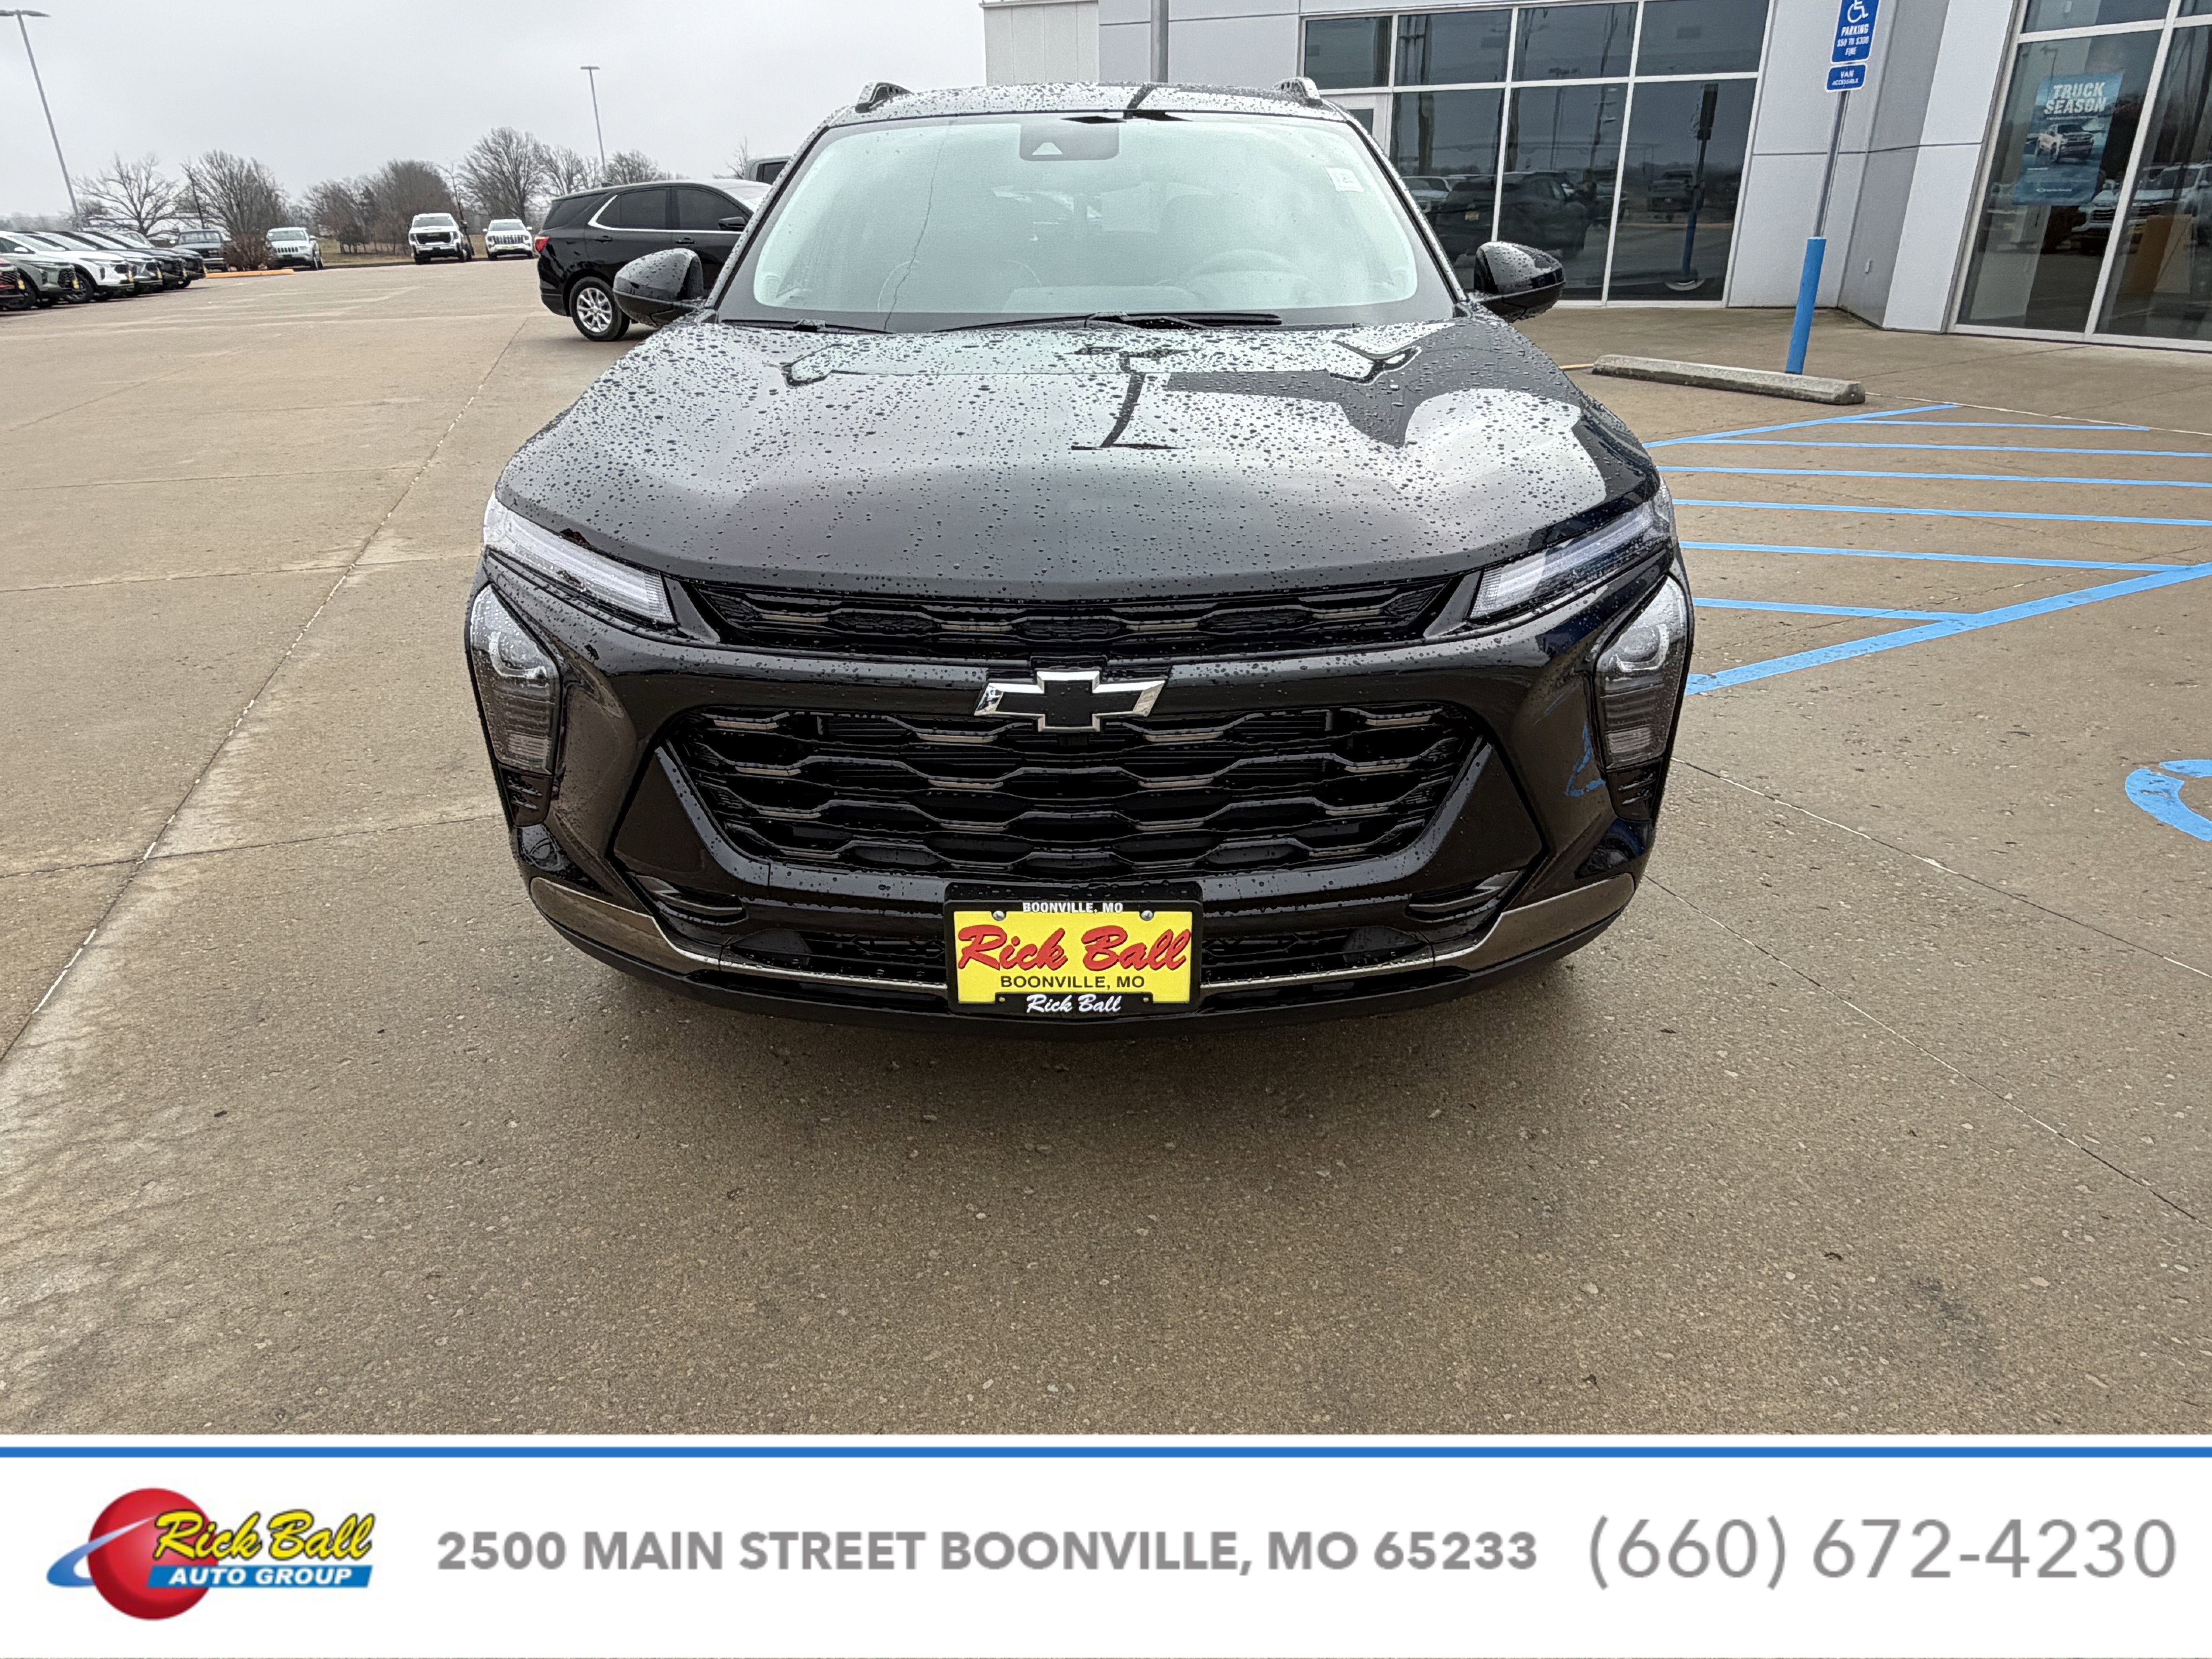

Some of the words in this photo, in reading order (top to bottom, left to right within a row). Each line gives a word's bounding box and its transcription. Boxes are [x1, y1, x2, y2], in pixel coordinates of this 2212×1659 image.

[1841, 24, 1869, 36] PARKING
[1845, 47, 1857, 56] FINE
[1840, 70, 1854, 79] VAN
[2053, 81, 2107, 100] TRUCK
[2043, 97, 2107, 115] SEASON
[1022, 902, 1098, 914] BOONVILLE,
[1102, 902, 1123, 913] MO
[958, 924, 1068, 971] Rick
[1081, 925, 1192, 971] Ball
[1001, 976, 1111, 990] BOONVILLE,
[1117, 975, 1145, 988] MO
[1026, 994, 1073, 1013] Rick
[1078, 994, 1122, 1013] Ball
